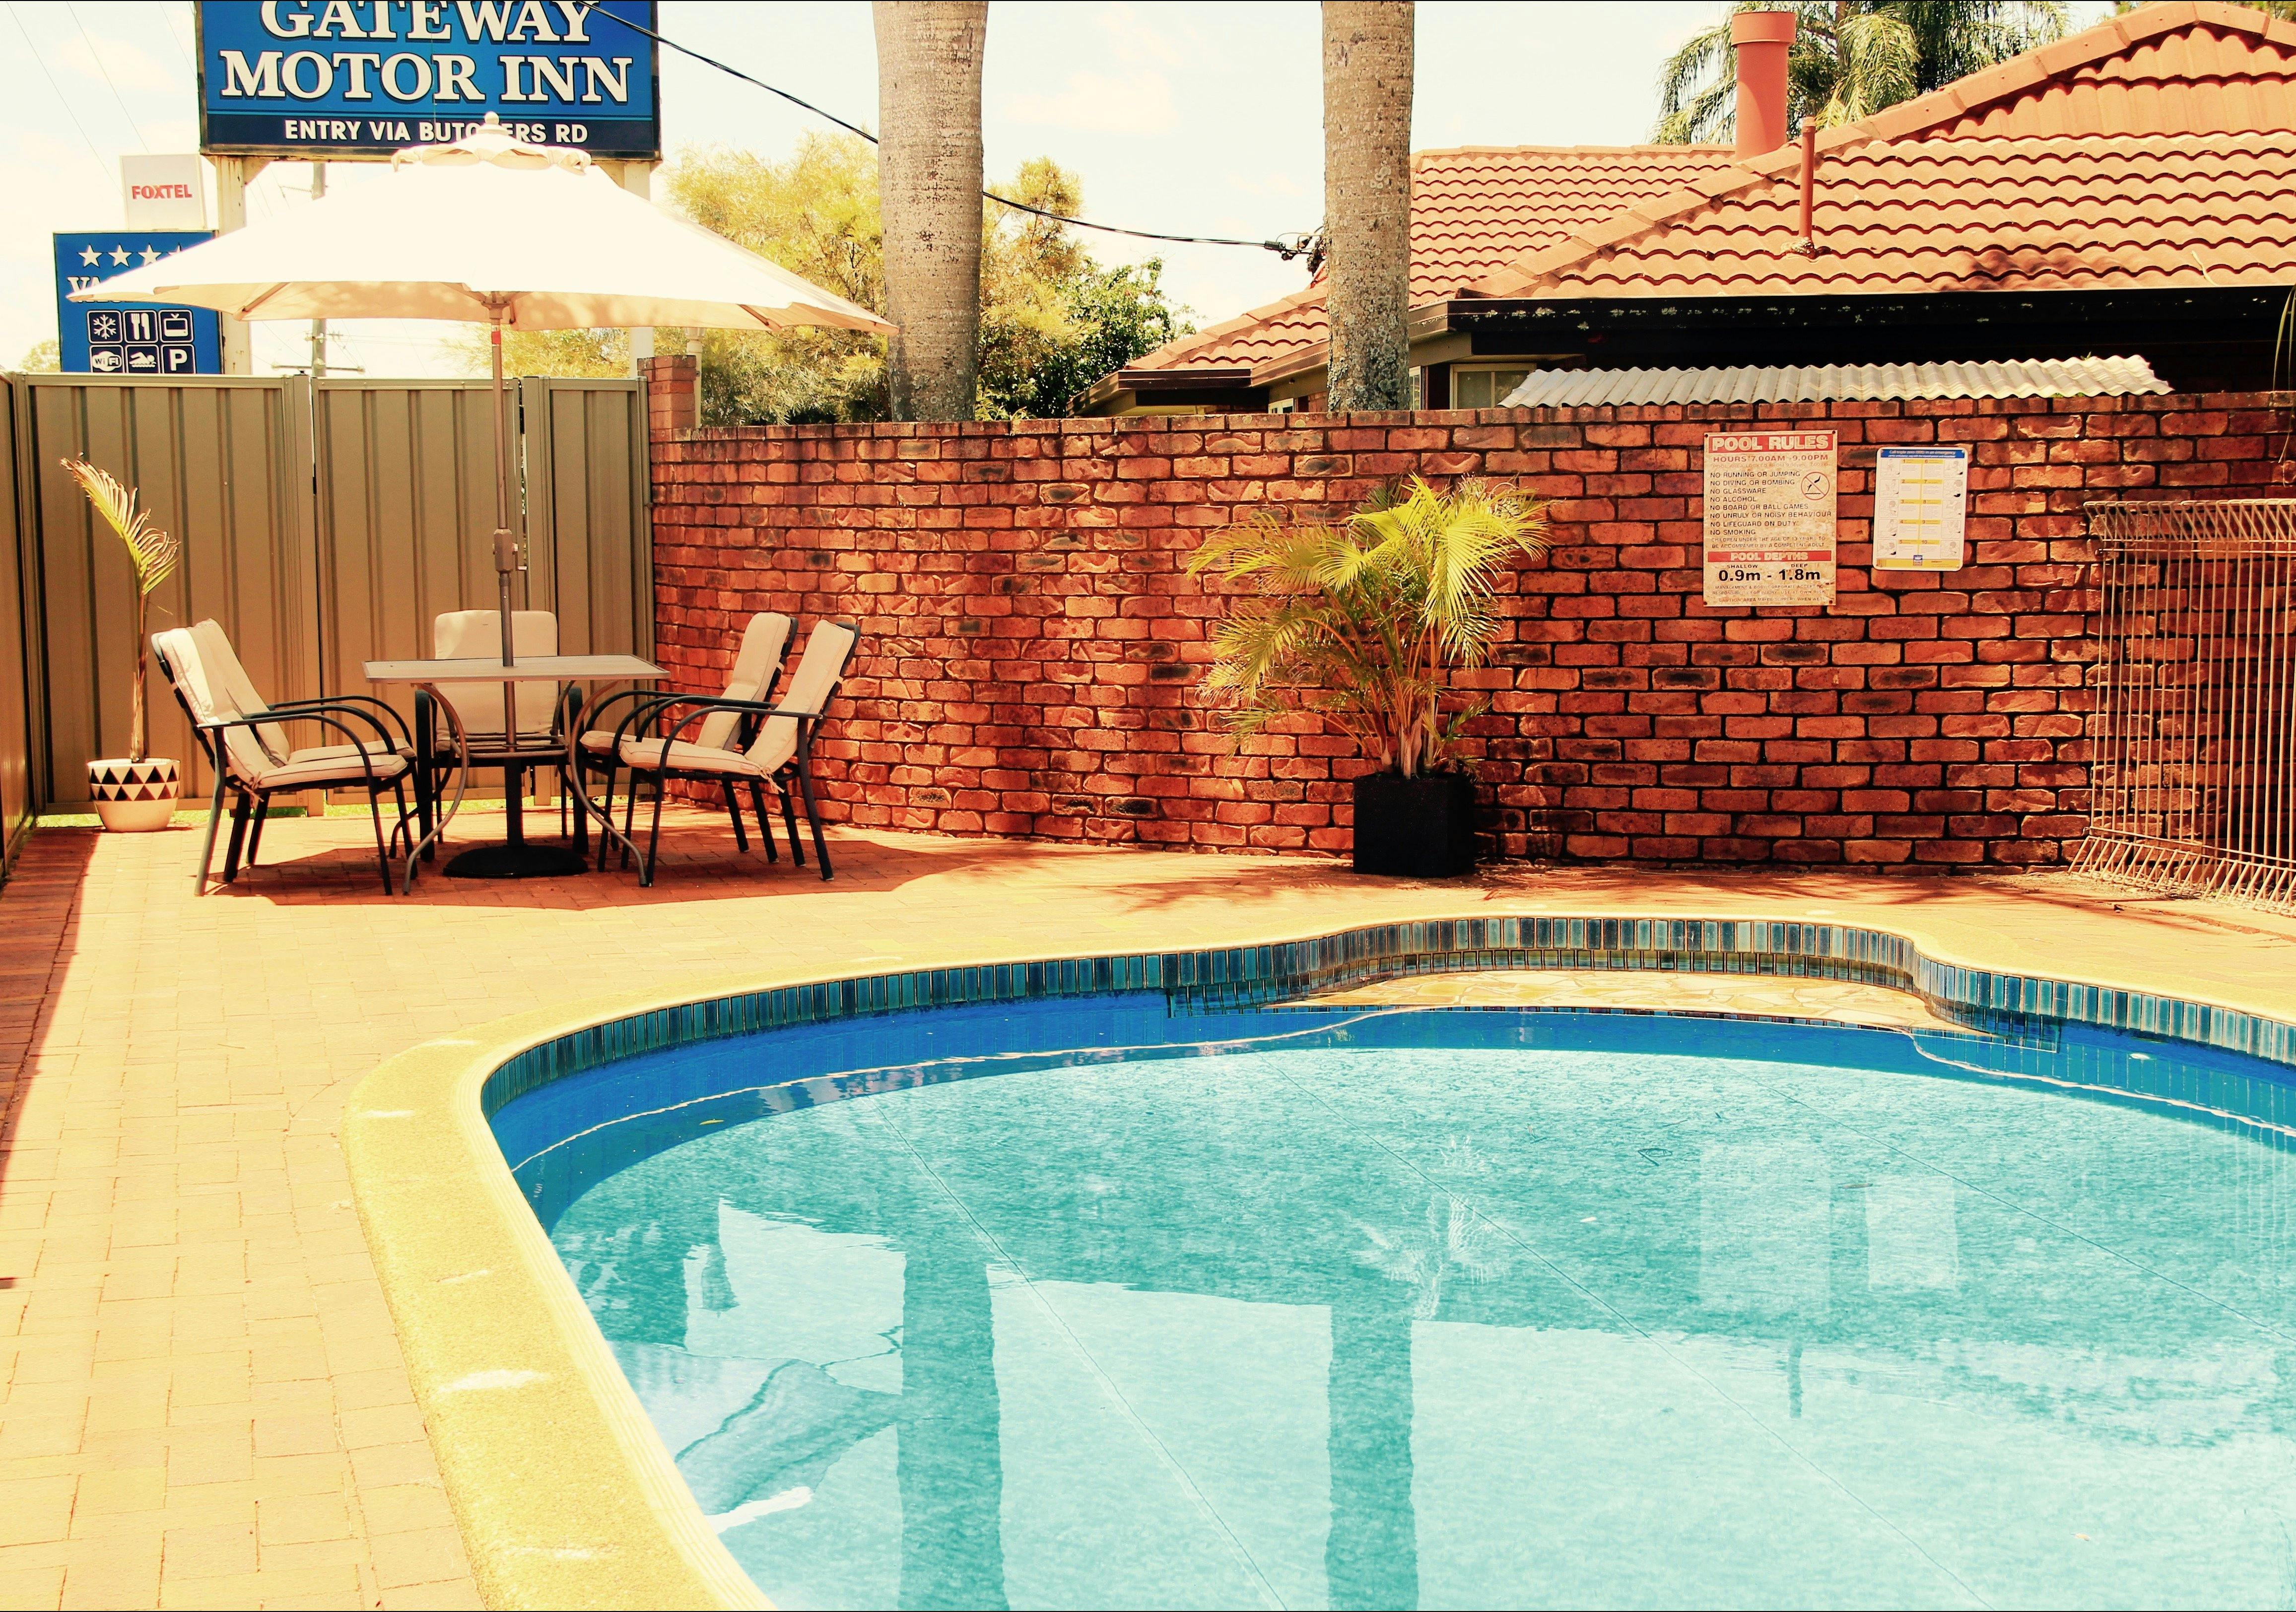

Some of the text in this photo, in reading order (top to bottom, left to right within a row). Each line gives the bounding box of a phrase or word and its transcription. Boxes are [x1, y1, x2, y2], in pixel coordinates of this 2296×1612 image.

[262, 0, 595, 42] GATEWAY
[220, 50, 633, 102] MOTOR INN
[285, 120, 588, 143] ENTRY VIA BUTRS RD
[132, 185, 193, 199] FOXTEL
[169, 349, 188, 371] P
[1712, 435, 1828, 451] POOL RULES
[1731, 551, 1808, 561] POOL DEPTHS
[1719, 570, 1760, 581] 0.9m
[1779, 569, 1820, 580] 1.8m
